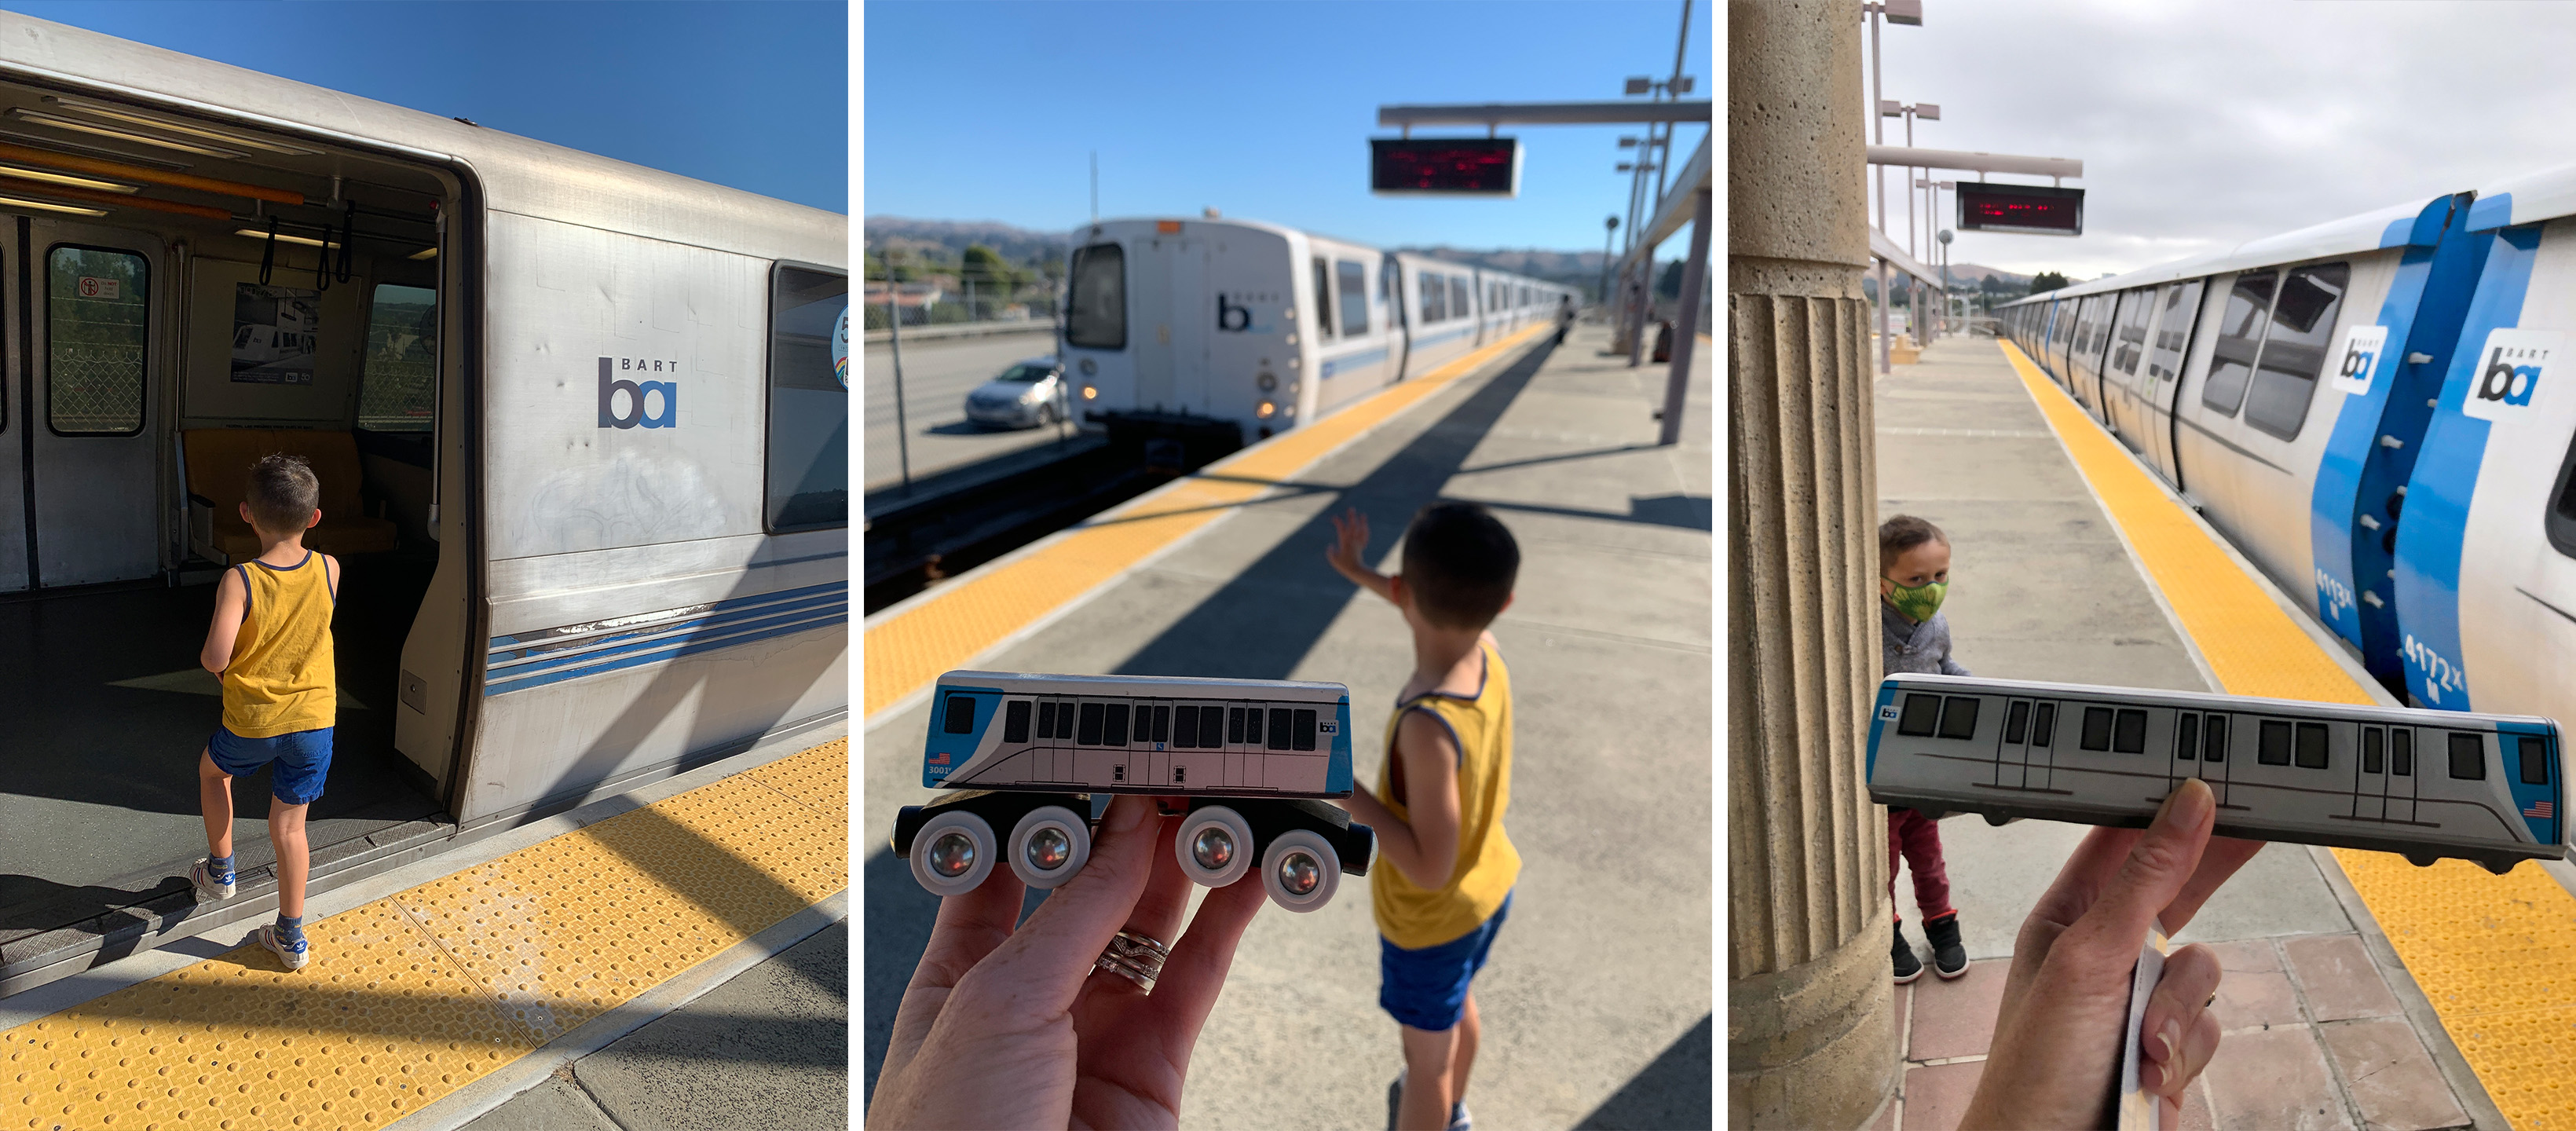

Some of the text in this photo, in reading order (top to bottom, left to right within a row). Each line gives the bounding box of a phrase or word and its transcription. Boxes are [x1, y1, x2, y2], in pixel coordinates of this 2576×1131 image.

[621, 357, 677, 372] BART
[2340, 338, 2374, 380] ba
[2506, 347, 2549, 359] BART
[301, 372, 310, 381] 50
[2477, 347, 2542, 407] ba
[598, 357, 677, 429] ba
